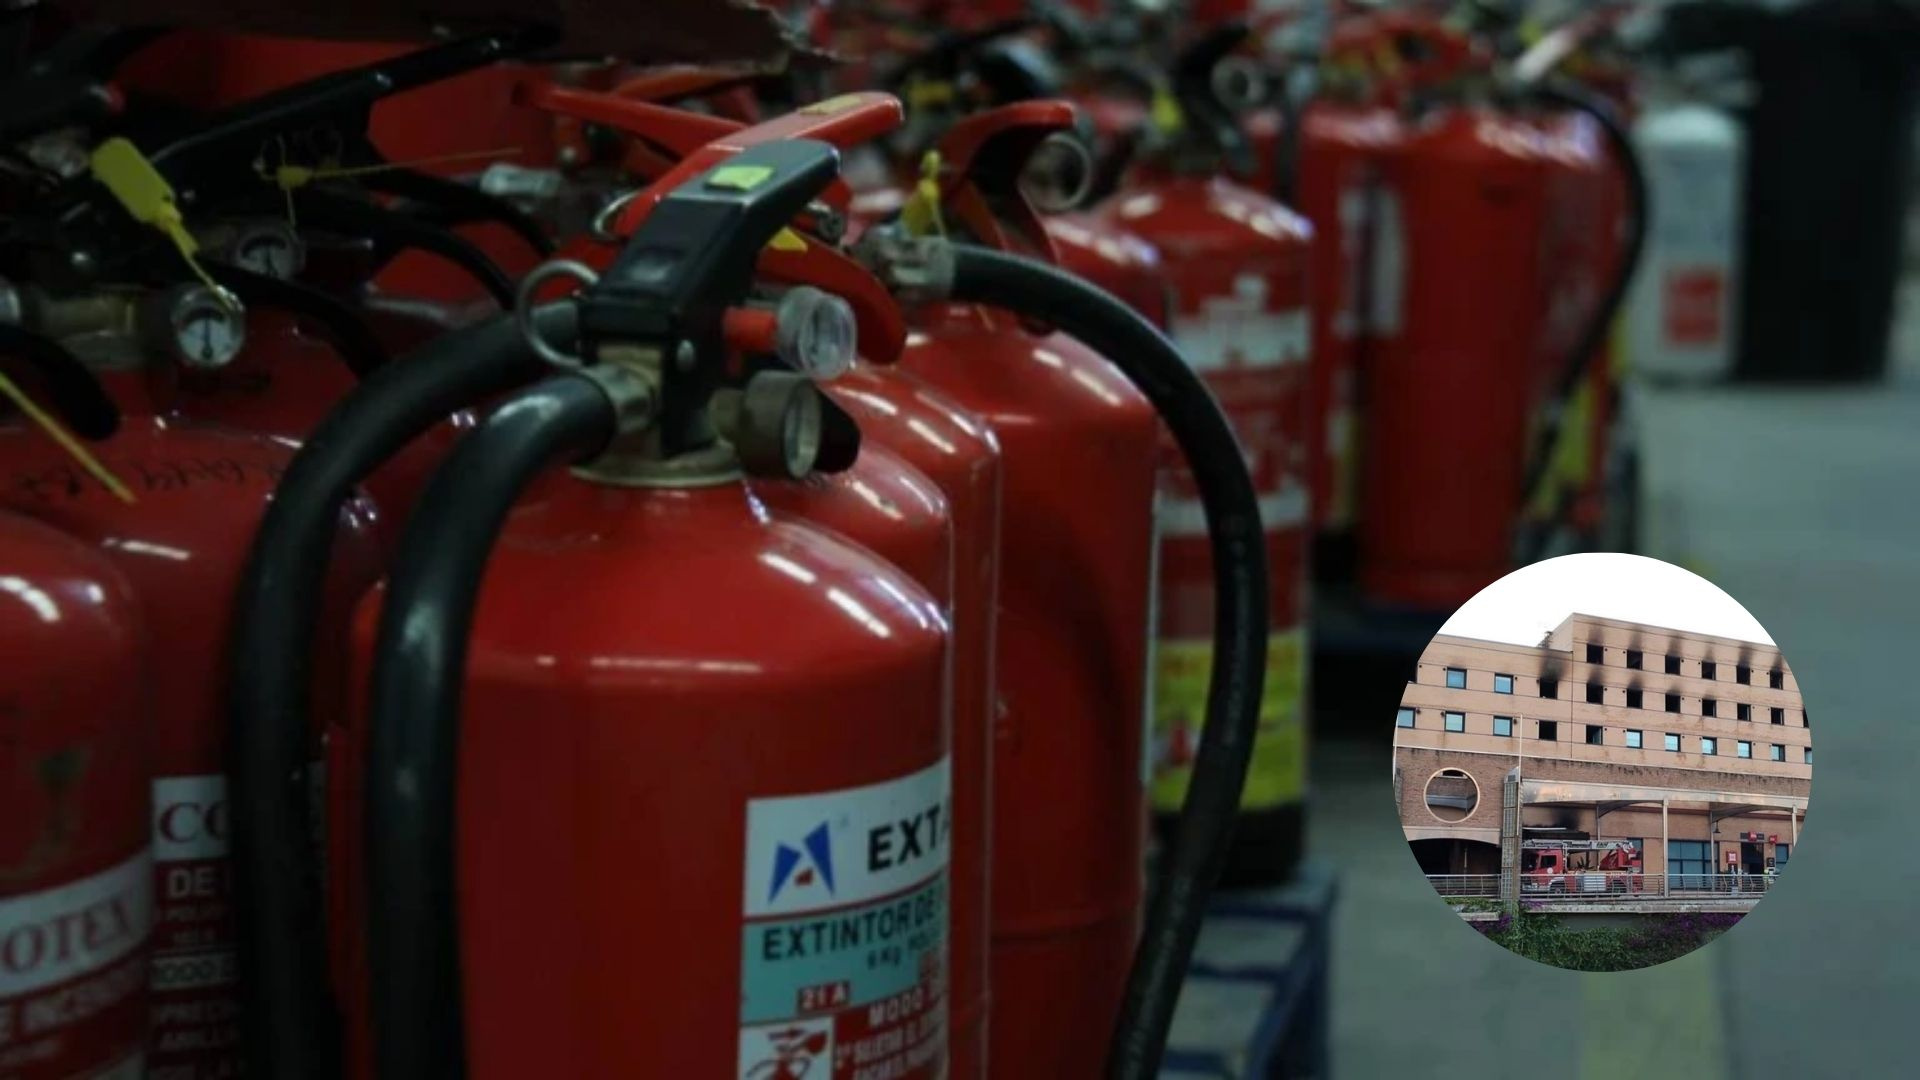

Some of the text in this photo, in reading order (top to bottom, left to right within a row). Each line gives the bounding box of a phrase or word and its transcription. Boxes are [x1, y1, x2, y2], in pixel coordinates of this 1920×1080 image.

[168, 866, 217, 899] DE
[763, 901, 911, 961] EXTINTOR
[868, 986, 924, 1028] MODO
